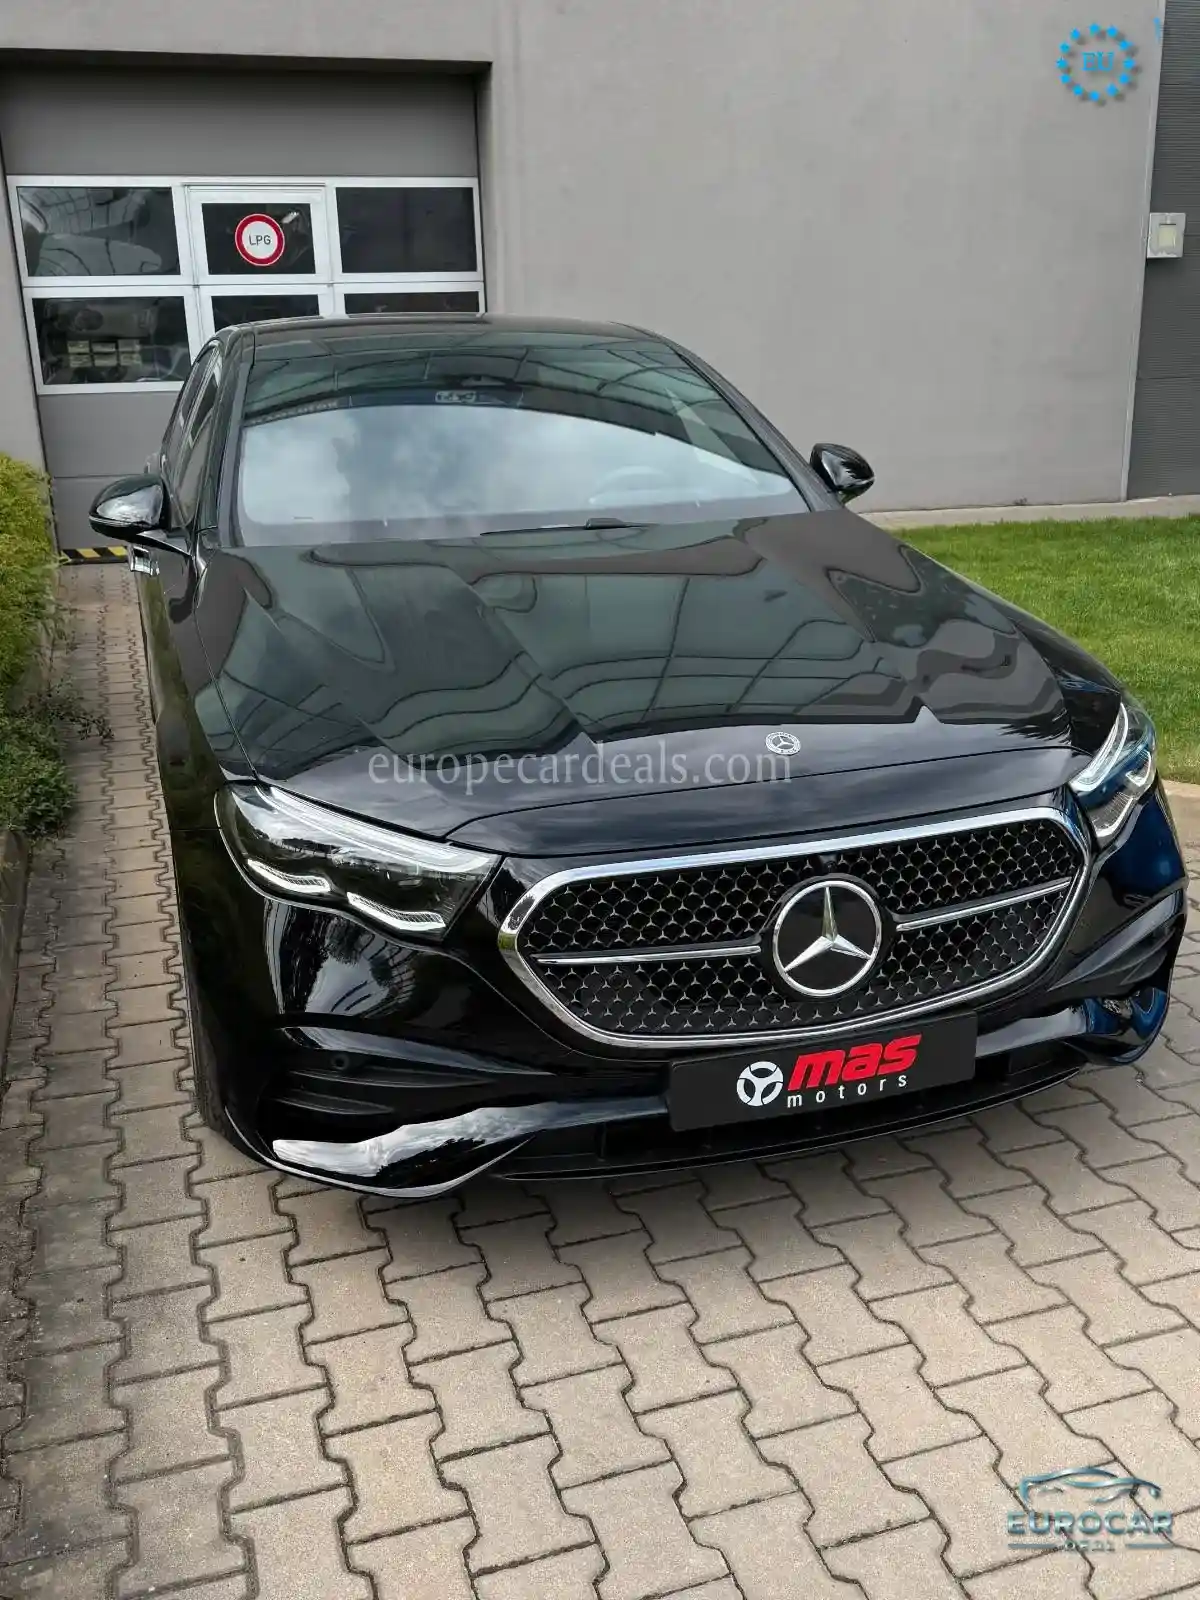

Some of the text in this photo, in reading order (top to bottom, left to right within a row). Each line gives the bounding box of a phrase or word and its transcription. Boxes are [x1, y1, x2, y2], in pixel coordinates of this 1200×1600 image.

[248, 233, 272, 247] LPG
[787, 1034, 922, 1091] mas
[786, 1074, 908, 1108] motors
